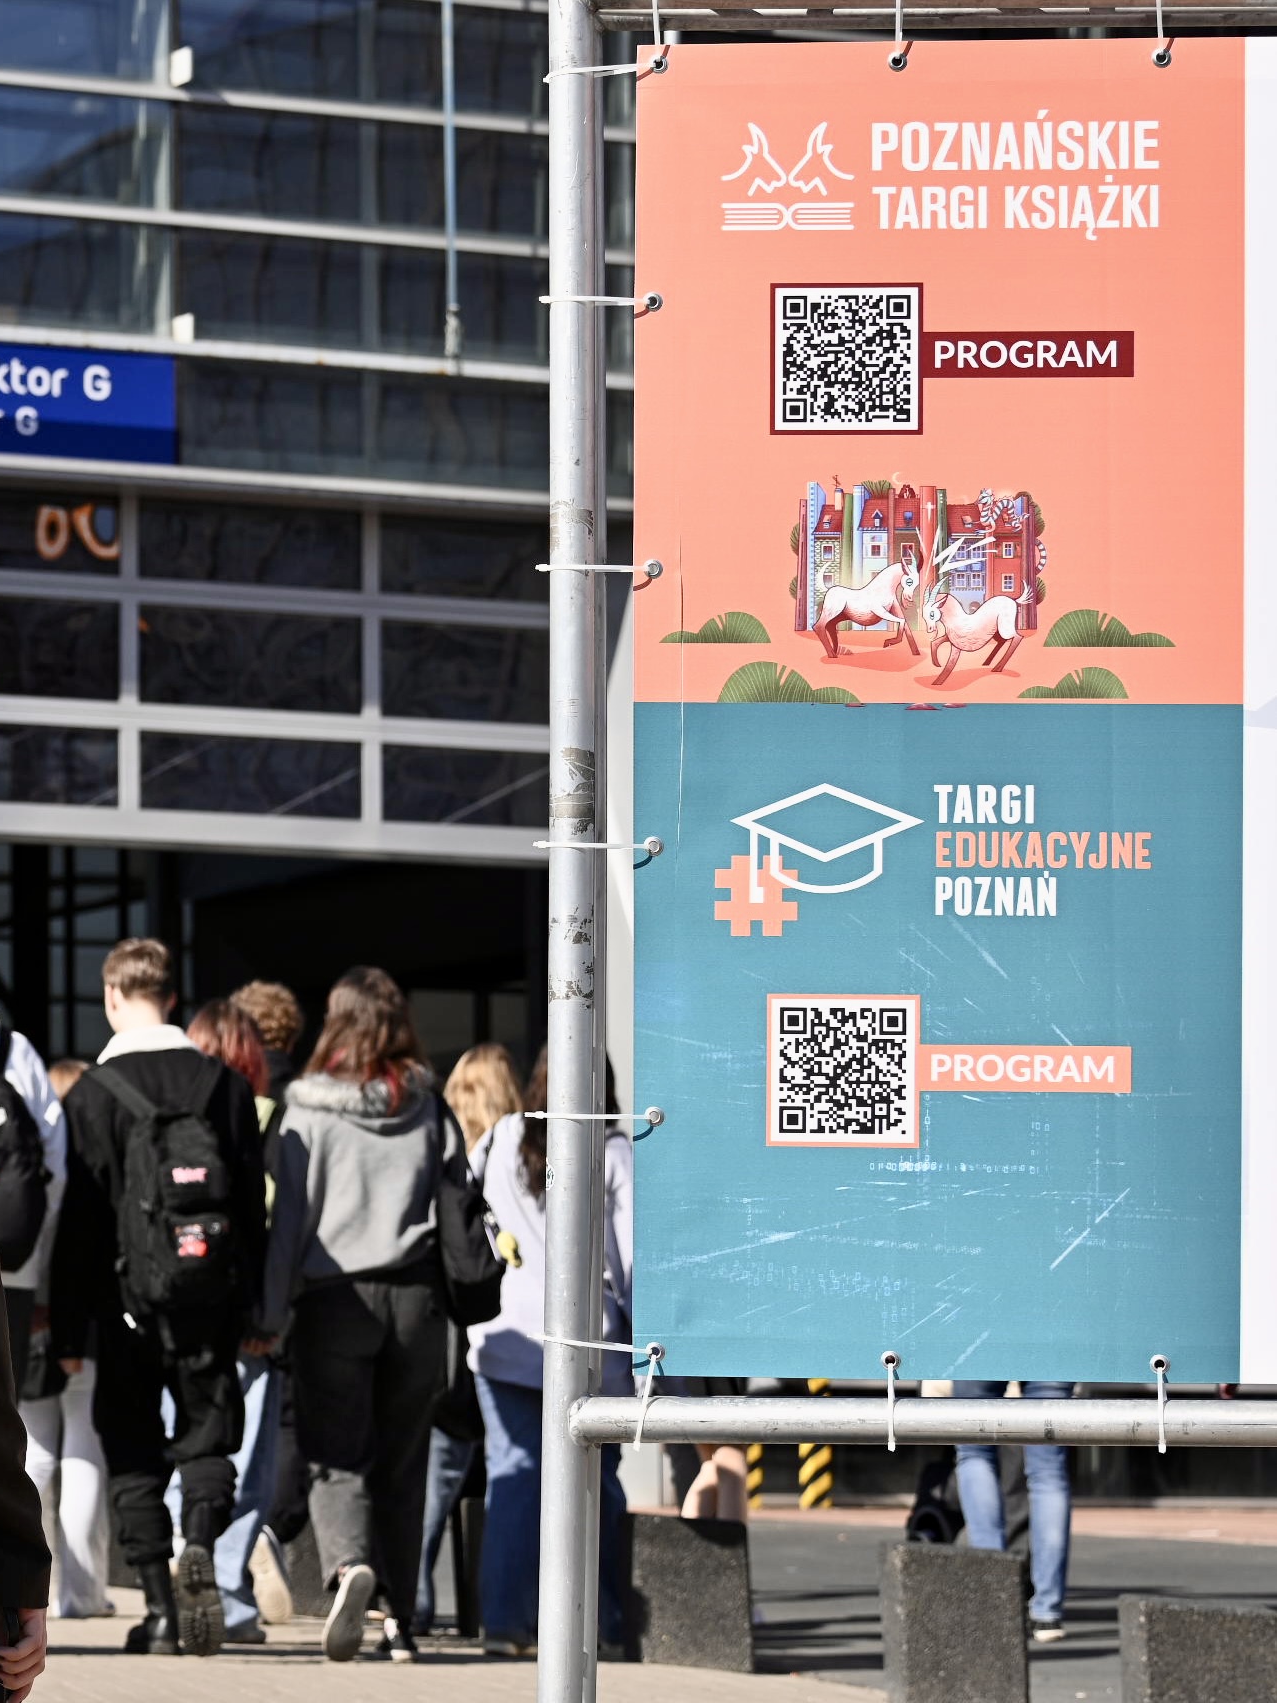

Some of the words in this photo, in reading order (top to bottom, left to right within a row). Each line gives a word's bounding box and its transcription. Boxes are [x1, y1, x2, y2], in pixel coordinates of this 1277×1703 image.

[871, 109, 1160, 172] POZNAŃSKIE
[871, 185, 988, 230] TARGI
[1004, 174, 1159, 241] KSIĄŻKI
[934, 340, 1117, 369] PROGRAM
[82, 364, 112, 402] G
[14, 405, 39, 435] G
[933, 784, 1035, 825] TARGI
[935, 830, 1152, 870] EDUKACYJNE
[934, 871, 1057, 917] POZNAŃ
[930, 1053, 1115, 1083] PROGRAM
